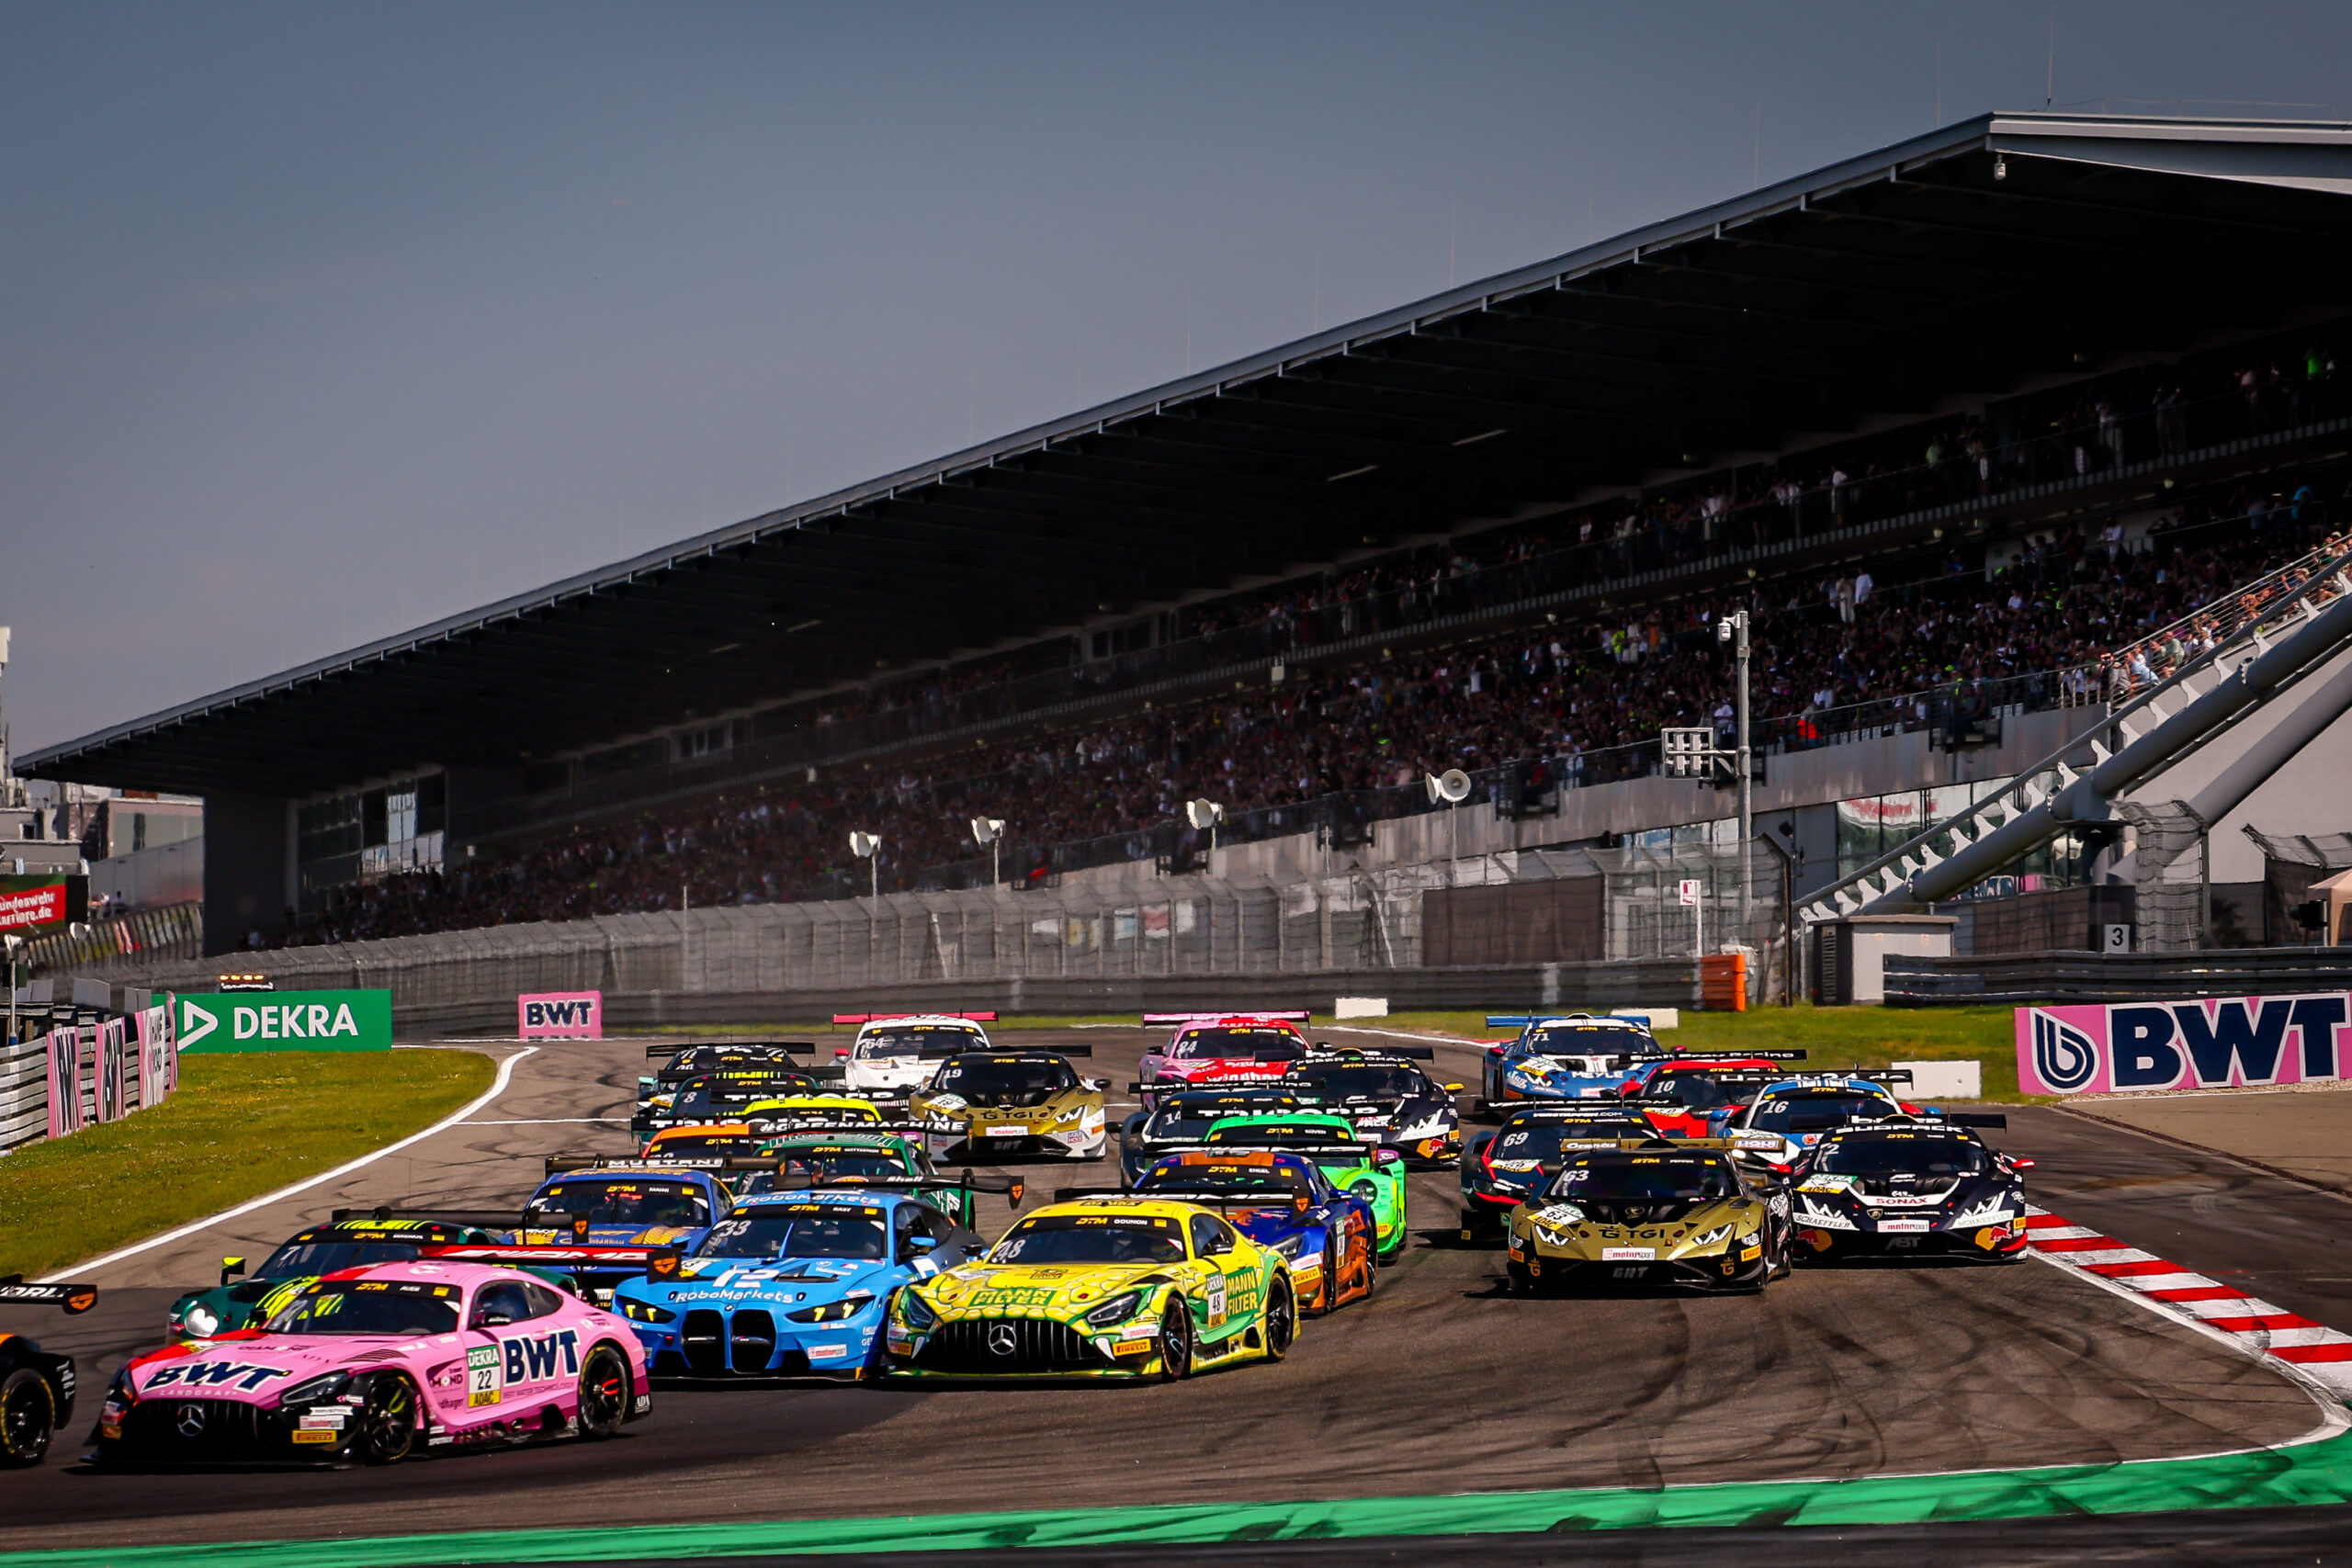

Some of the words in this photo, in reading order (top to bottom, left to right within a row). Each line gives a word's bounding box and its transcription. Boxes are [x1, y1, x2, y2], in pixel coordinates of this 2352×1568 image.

[0, 890, 55, 910] undeswehr
[0, 907, 52, 927] arriere.de
[2111, 927, 2123, 947] 3
[526, 1001, 595, 1026] BWT
[233, 1003, 359, 1040] DEKRA
[866, 1038, 886, 1050] 64
[1532, 1032, 1550, 1042] 71
[2111, 996, 2350, 1090] BWT
[944, 1069, 963, 1079] 19
[1572, 1070, 1625, 1079] MEYLE
[1655, 1080, 1676, 1094] 10
[684, 1091, 697, 1103] 8
[1763, 1100, 1789, 1114] 16
[1165, 1111, 1182, 1126] 14
[1503, 1132, 1530, 1147] 69
[886, 1175, 923, 1183] Shell
[1563, 1169, 1589, 1181] 63
[721, 1219, 752, 1237] 33
[1075, 1217, 1108, 1225] DTM
[1532, 1215, 1557, 1229] ADAC
[1795, 1214, 1850, 1228] SCHAEFFLER
[1625, 1229, 1665, 1239] TGI
[279, 1246, 301, 1261] 7
[996, 1239, 1026, 1260] 48
[1613, 1250, 1654, 1259] motorsport
[356, 1282, 390, 1292] DTM
[1227, 1271, 1257, 1296] MANN
[674, 1289, 795, 1304] RoboMarkets
[974, 1296, 1050, 1306] FILTER
[978, 1289, 1053, 1298] MANN
[1212, 1294, 1221, 1313] 48
[1227, 1292, 1259, 1317] FILTER
[1116, 1341, 1148, 1355] PIRELLI
[468, 1348, 500, 1369] DEKRA
[504, 1330, 579, 1383] BWT
[142, 1361, 286, 1393] BWT
[477, 1370, 492, 1391] 22
[472, 1391, 495, 1406] ADAC
